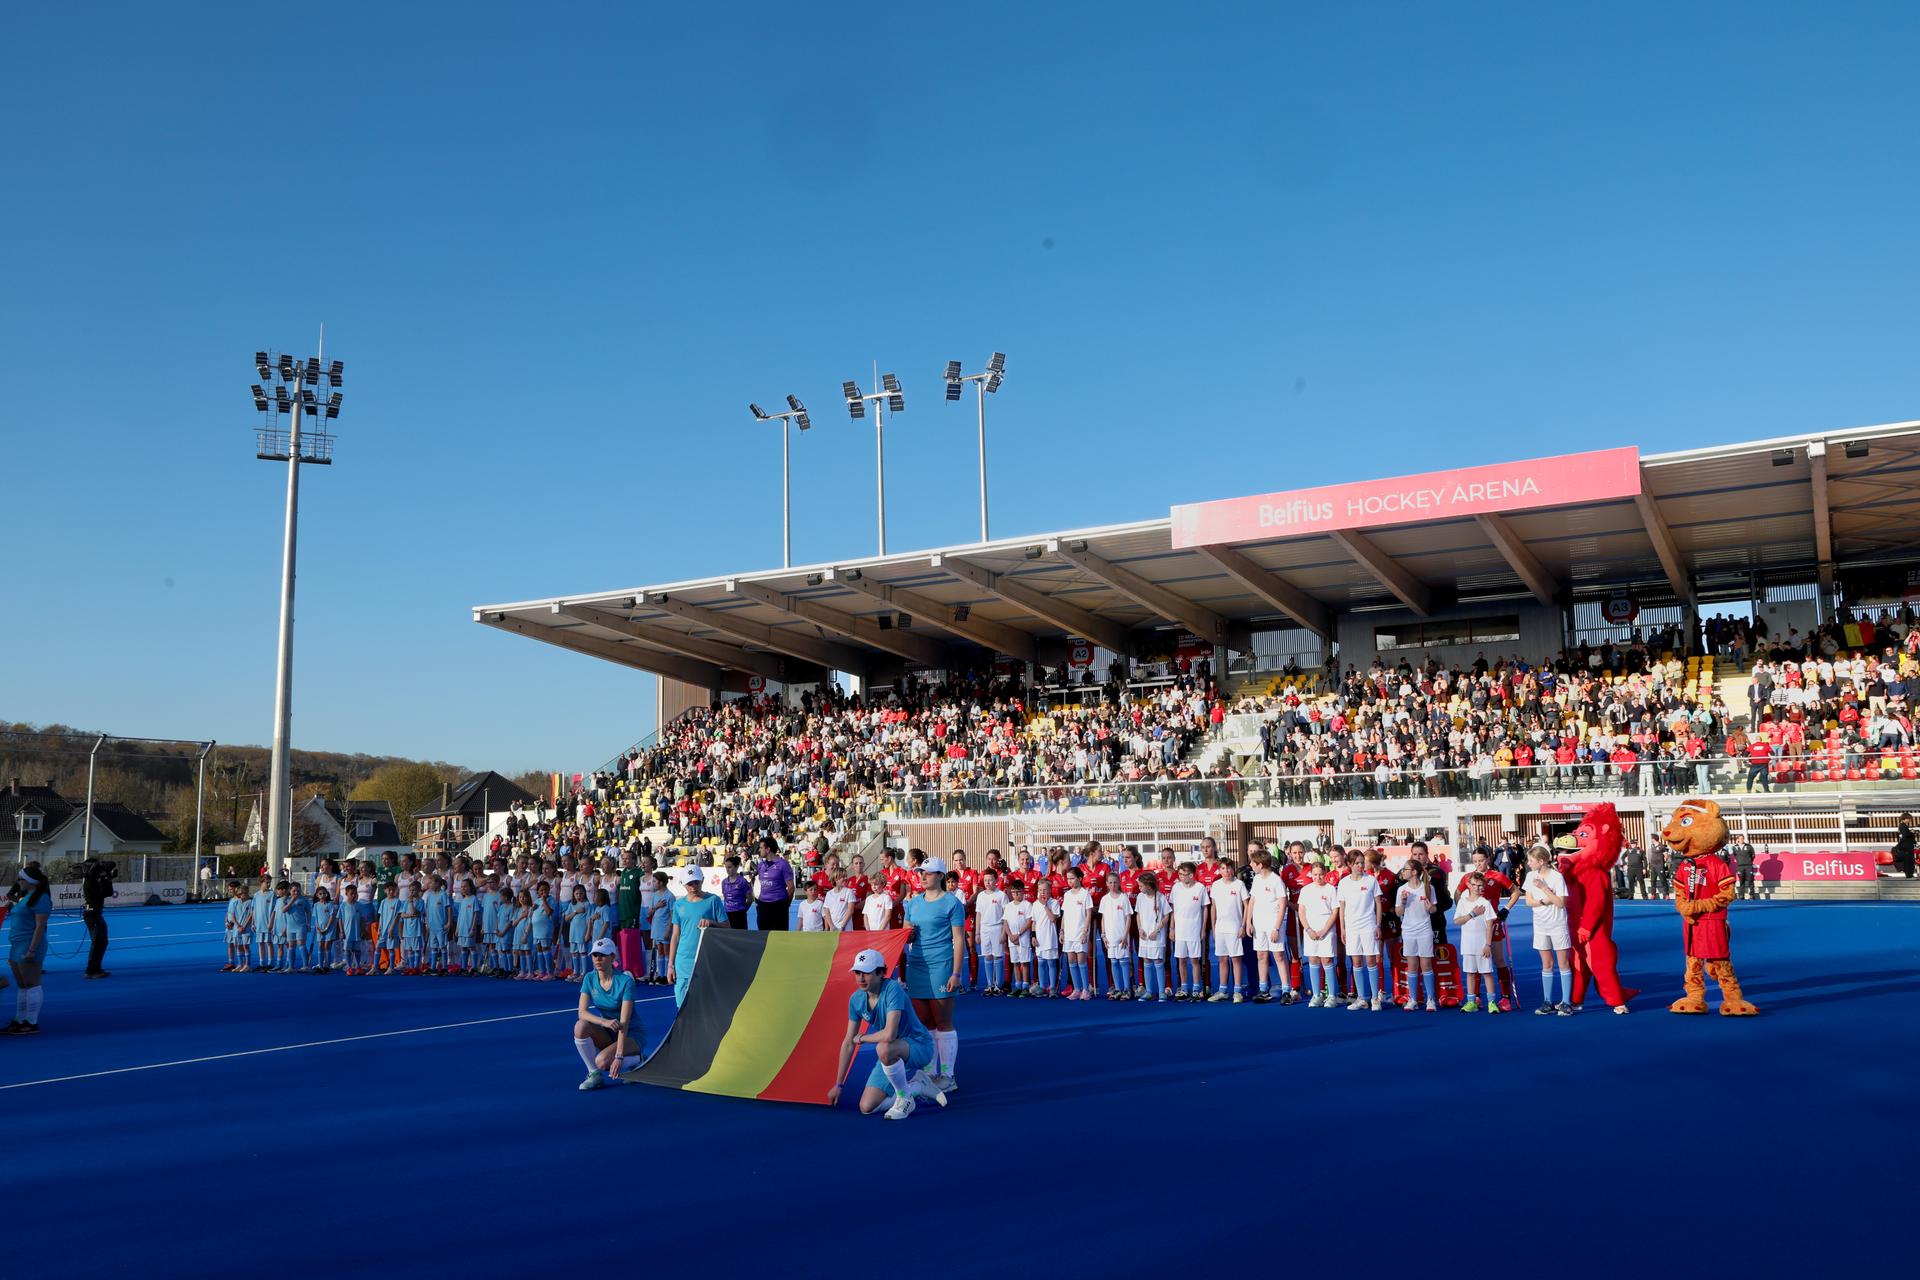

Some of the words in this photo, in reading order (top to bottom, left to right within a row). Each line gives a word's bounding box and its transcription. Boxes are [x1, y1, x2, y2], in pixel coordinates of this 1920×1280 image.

[1259, 499, 1333, 528] Belfius
[1347, 487, 1446, 517] HOCKEY
[1451, 477, 1540, 505] ARENA
[1611, 602, 1629, 614] A3
[1075, 650, 1088, 659] A2
[1803, 859, 1865, 876] Belfius
[59, 893, 82, 901] OSAKA
